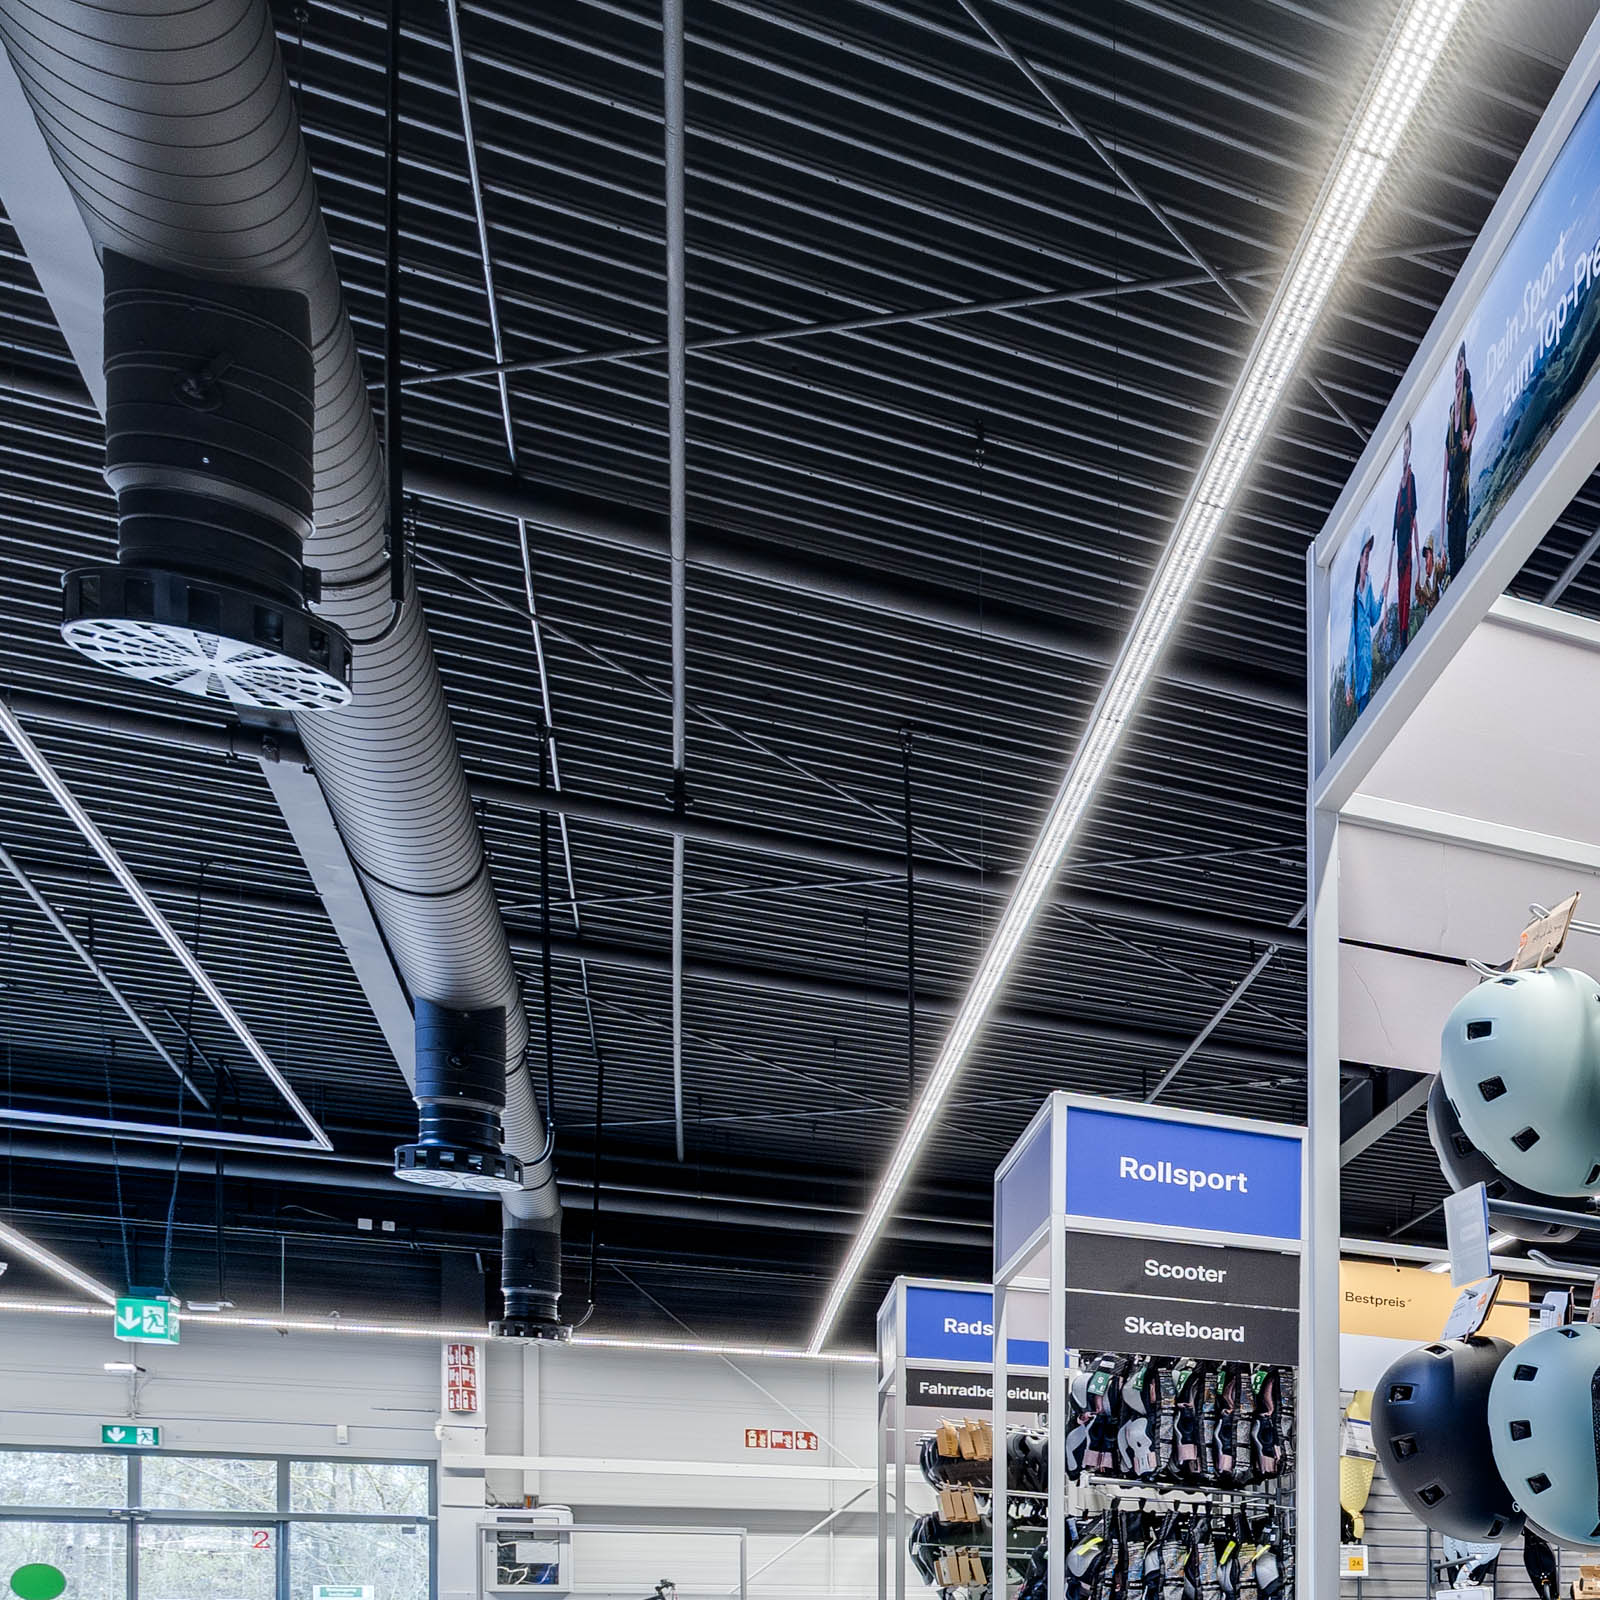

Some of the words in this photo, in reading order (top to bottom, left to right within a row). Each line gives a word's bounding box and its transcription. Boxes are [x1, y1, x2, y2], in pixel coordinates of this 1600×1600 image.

[1486, 312, 1519, 391] Dein
[1521, 230, 1566, 334] Sport
[1503, 344, 1535, 417] zum
[1119, 1156, 1248, 1194] Rollsport
[1144, 1258, 1228, 1284] Scooter
[1345, 1291, 1406, 1308] Bestpreis
[944, 1317, 993, 1336] Rads
[1124, 1315, 1246, 1344] Skateboard
[919, 1381, 1050, 1403] Fahrradbeeidun
[253, 1530, 270, 1549] 2
